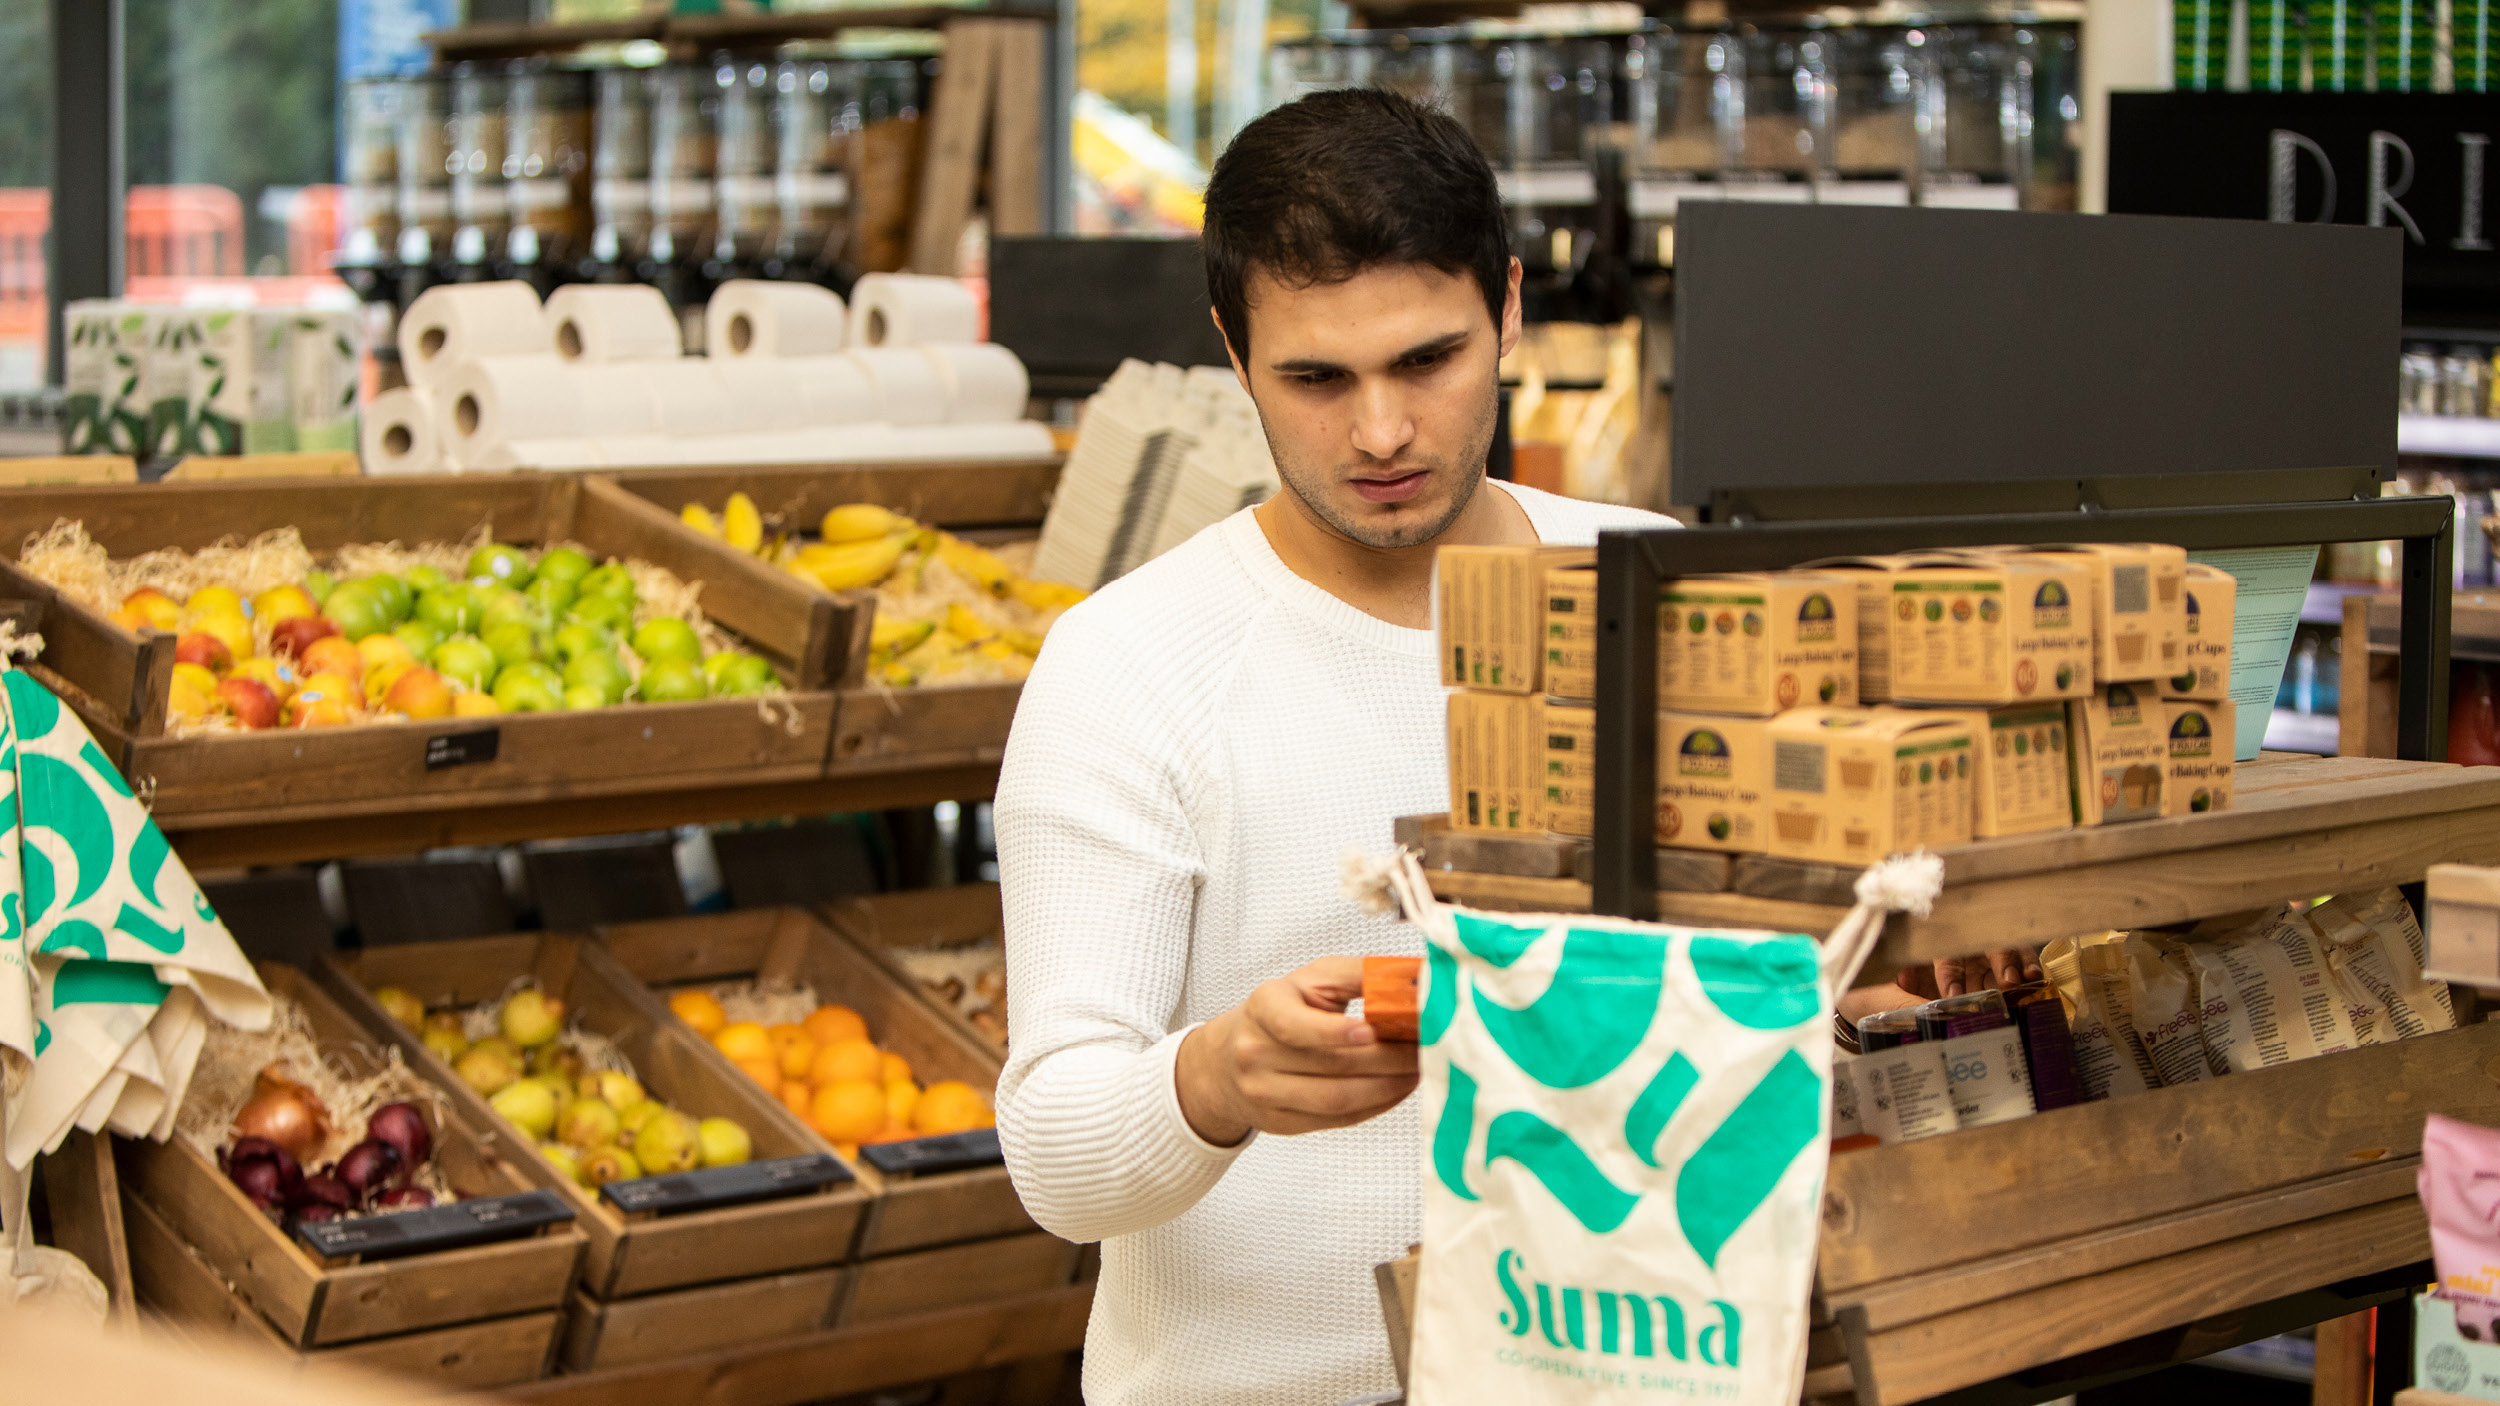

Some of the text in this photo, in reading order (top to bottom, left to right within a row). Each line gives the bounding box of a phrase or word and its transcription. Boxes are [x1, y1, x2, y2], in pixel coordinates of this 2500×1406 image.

[2196, 639, 2226, 655] Cups
[2176, 763, 2209, 780] Baking
[2209, 763, 2231, 779] Cups
[2157, 1012, 2198, 1039] freee
[1496, 1248, 1741, 1367] Suma
[1640, 1374, 1697, 1396] SINCE
